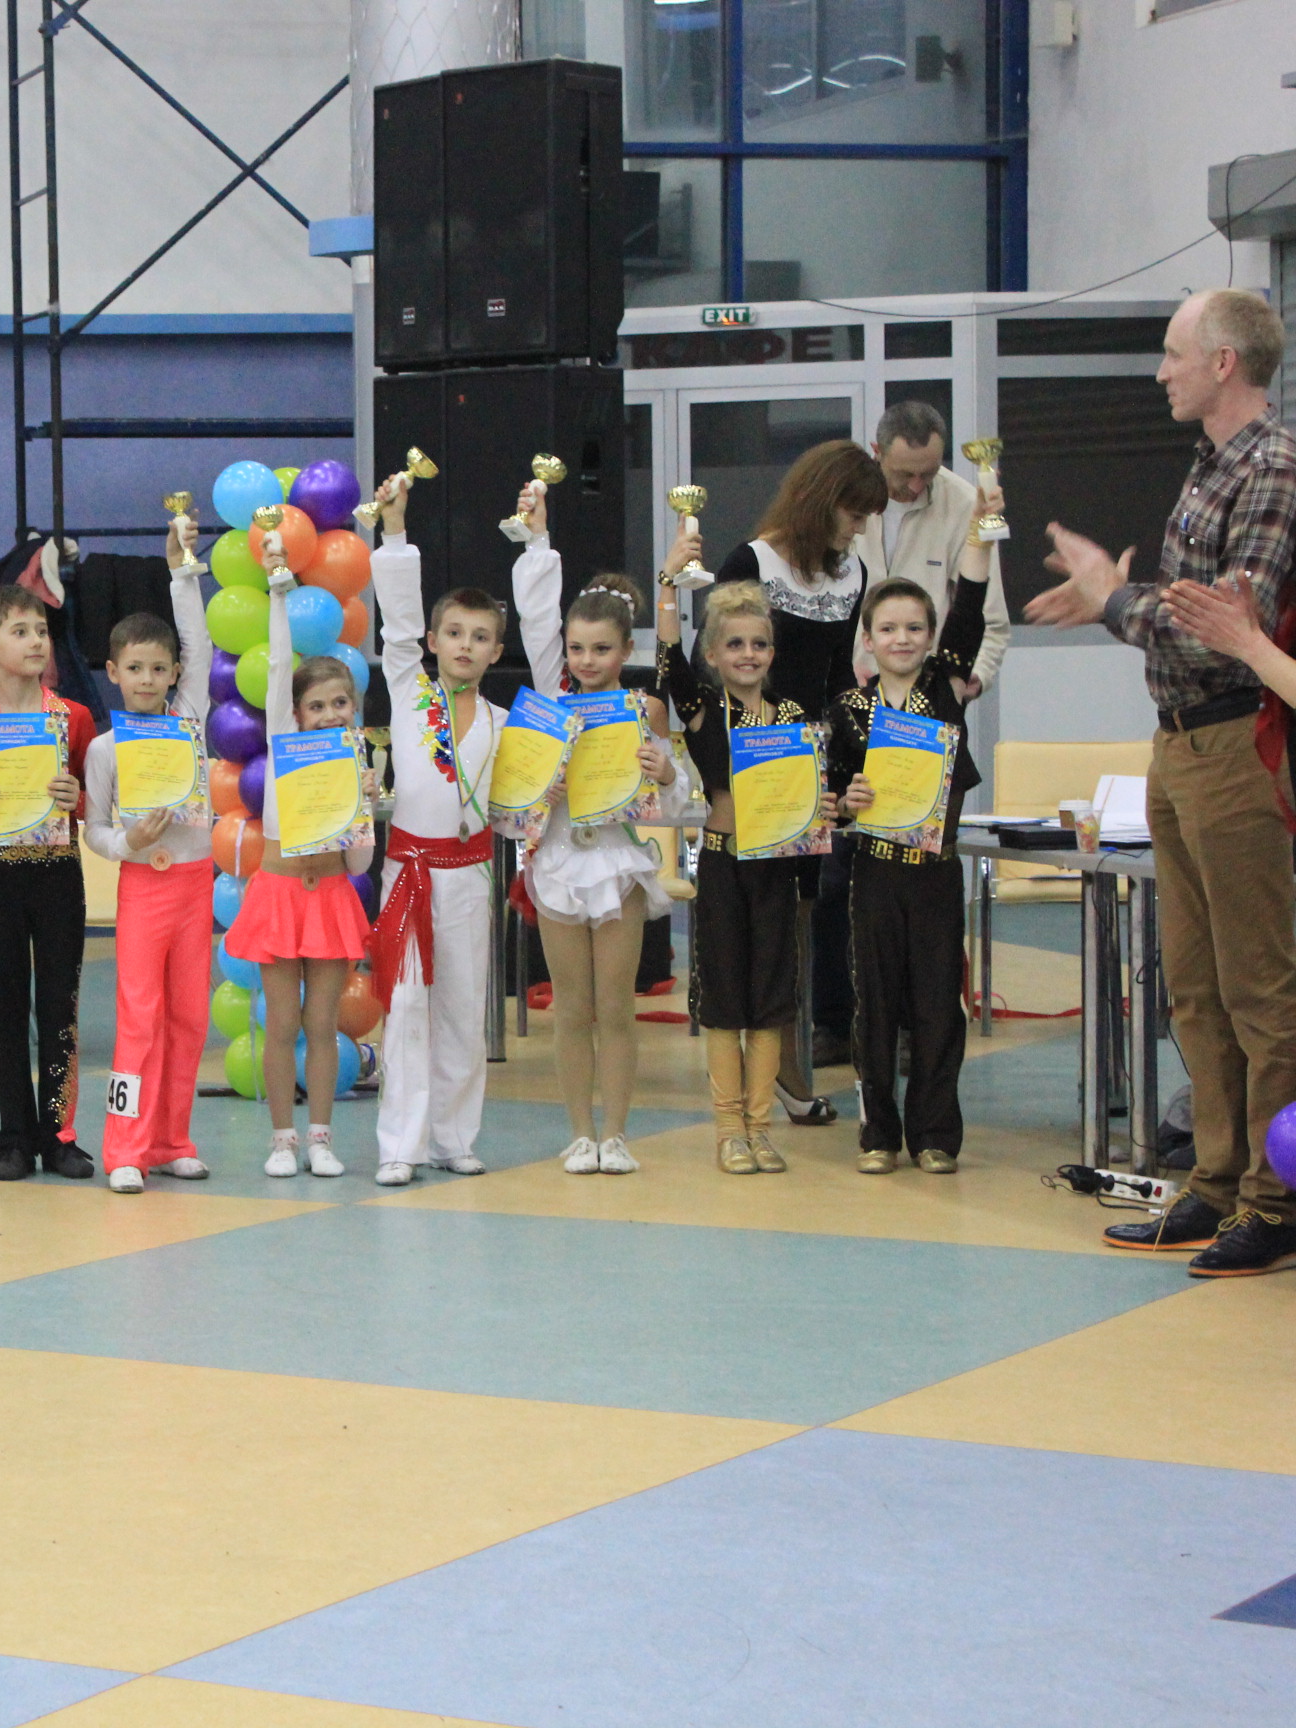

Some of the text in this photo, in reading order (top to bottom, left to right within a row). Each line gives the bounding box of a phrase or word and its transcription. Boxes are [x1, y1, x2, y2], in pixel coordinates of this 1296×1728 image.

[704, 308, 747, 323] EXIT
[884, 720, 927, 738] ГРАМОТА
[285, 741, 332, 753] ГРАМОТА
[744, 736, 792, 748] ГРАМОТА
[108, 1078, 128, 1112] 46
